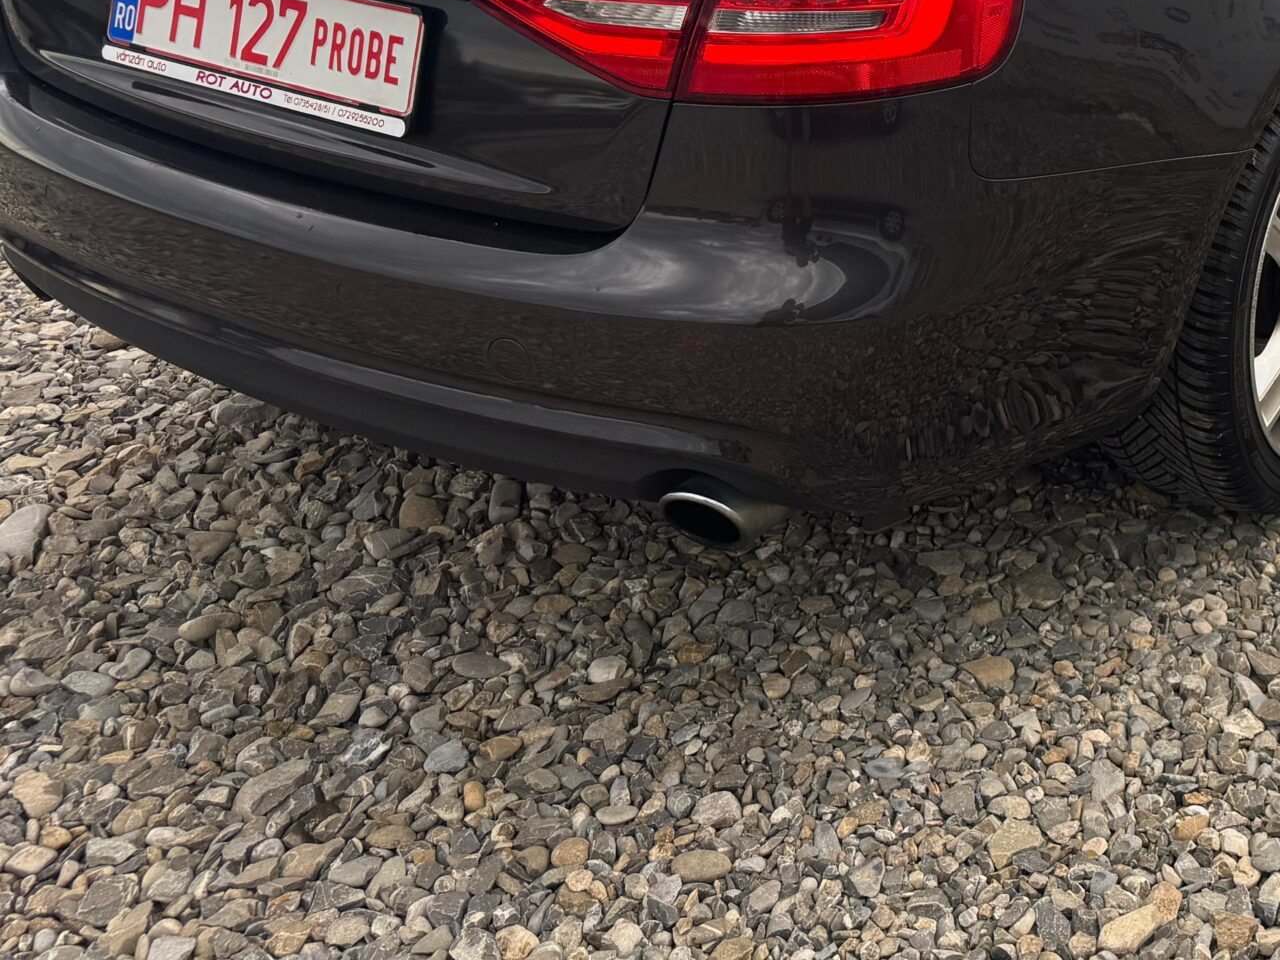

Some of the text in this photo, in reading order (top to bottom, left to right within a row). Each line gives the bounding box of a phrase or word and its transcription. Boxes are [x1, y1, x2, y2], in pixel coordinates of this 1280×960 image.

[114, 2, 135, 31] RO
[310, 18, 404, 86] PROBE
[196, 71, 226, 87] ROT
[229, 80, 273, 100] AUTO
